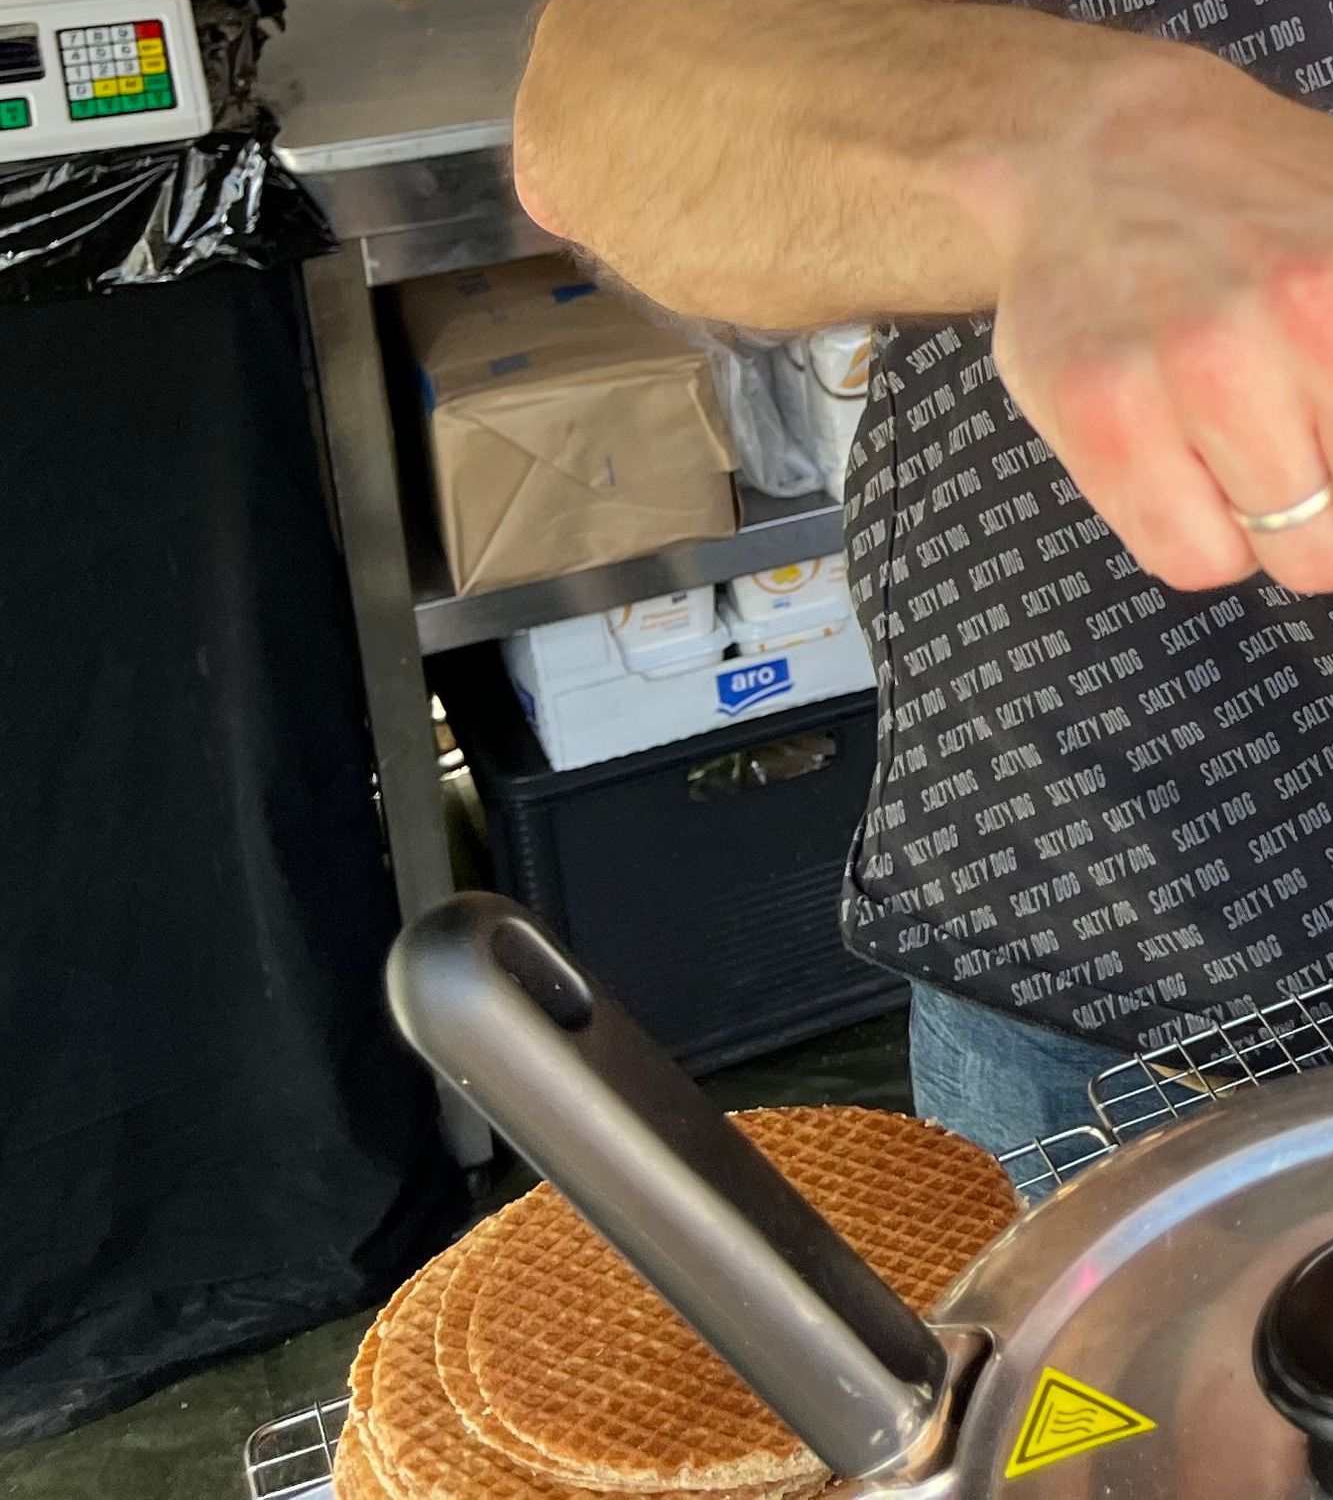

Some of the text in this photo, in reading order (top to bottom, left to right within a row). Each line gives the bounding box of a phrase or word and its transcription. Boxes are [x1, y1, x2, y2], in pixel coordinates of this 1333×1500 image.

[978, 490, 1040, 537] SALTY DOG
[967, 547, 1025, 593] SALTY DOG
[1020, 570, 1092, 618] SALTY DOG
[1085, 586, 1167, 641] SALTY DOG
[1159, 595, 1246, 656] SALTY DOG
[1006, 629, 1072, 673] SALTY DOG
[1067, 647, 1145, 697] SALTY DOG
[731, 666, 776, 692] aro
[1138, 658, 1222, 715] SALTY DOG
[1212, 665, 1300, 729] SALTY DOG
[994, 685, 1065, 731] SALTY DOG
[1055, 705, 1132, 756] SALTY DOG
[1125, 721, 1206, 773] SALTY DOG
[1199, 730, 1281, 787] SALTY DOG
[1273, 753, 1324, 801] SALTY
[1171, 791, 1257, 853] SALTY DOG
[1247, 801, 1332, 864] SALTY DOG
[1008, 871, 1081, 918] SALTY DOG
[1222, 867, 1309, 931] SALTY DOG
